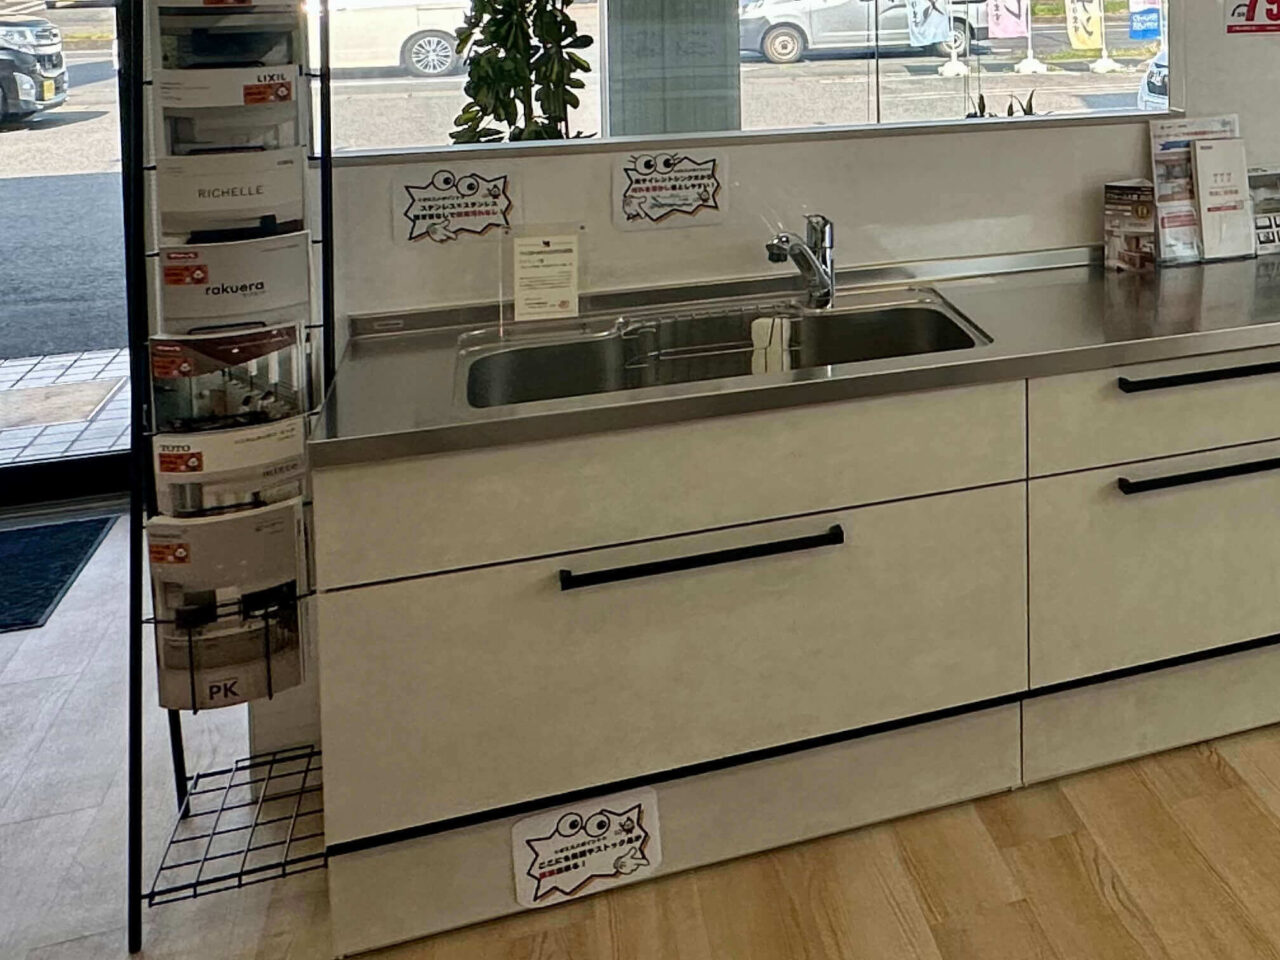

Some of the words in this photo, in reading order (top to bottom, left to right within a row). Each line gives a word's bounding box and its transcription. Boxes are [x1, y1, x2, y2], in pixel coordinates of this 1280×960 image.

[257, 73, 288, 83] LIXIL
[198, 185, 265, 199] RICHELLE
[205, 281, 265, 296] rakuera
[160, 444, 191, 453] TOTO
[208, 679, 240, 701] PK
